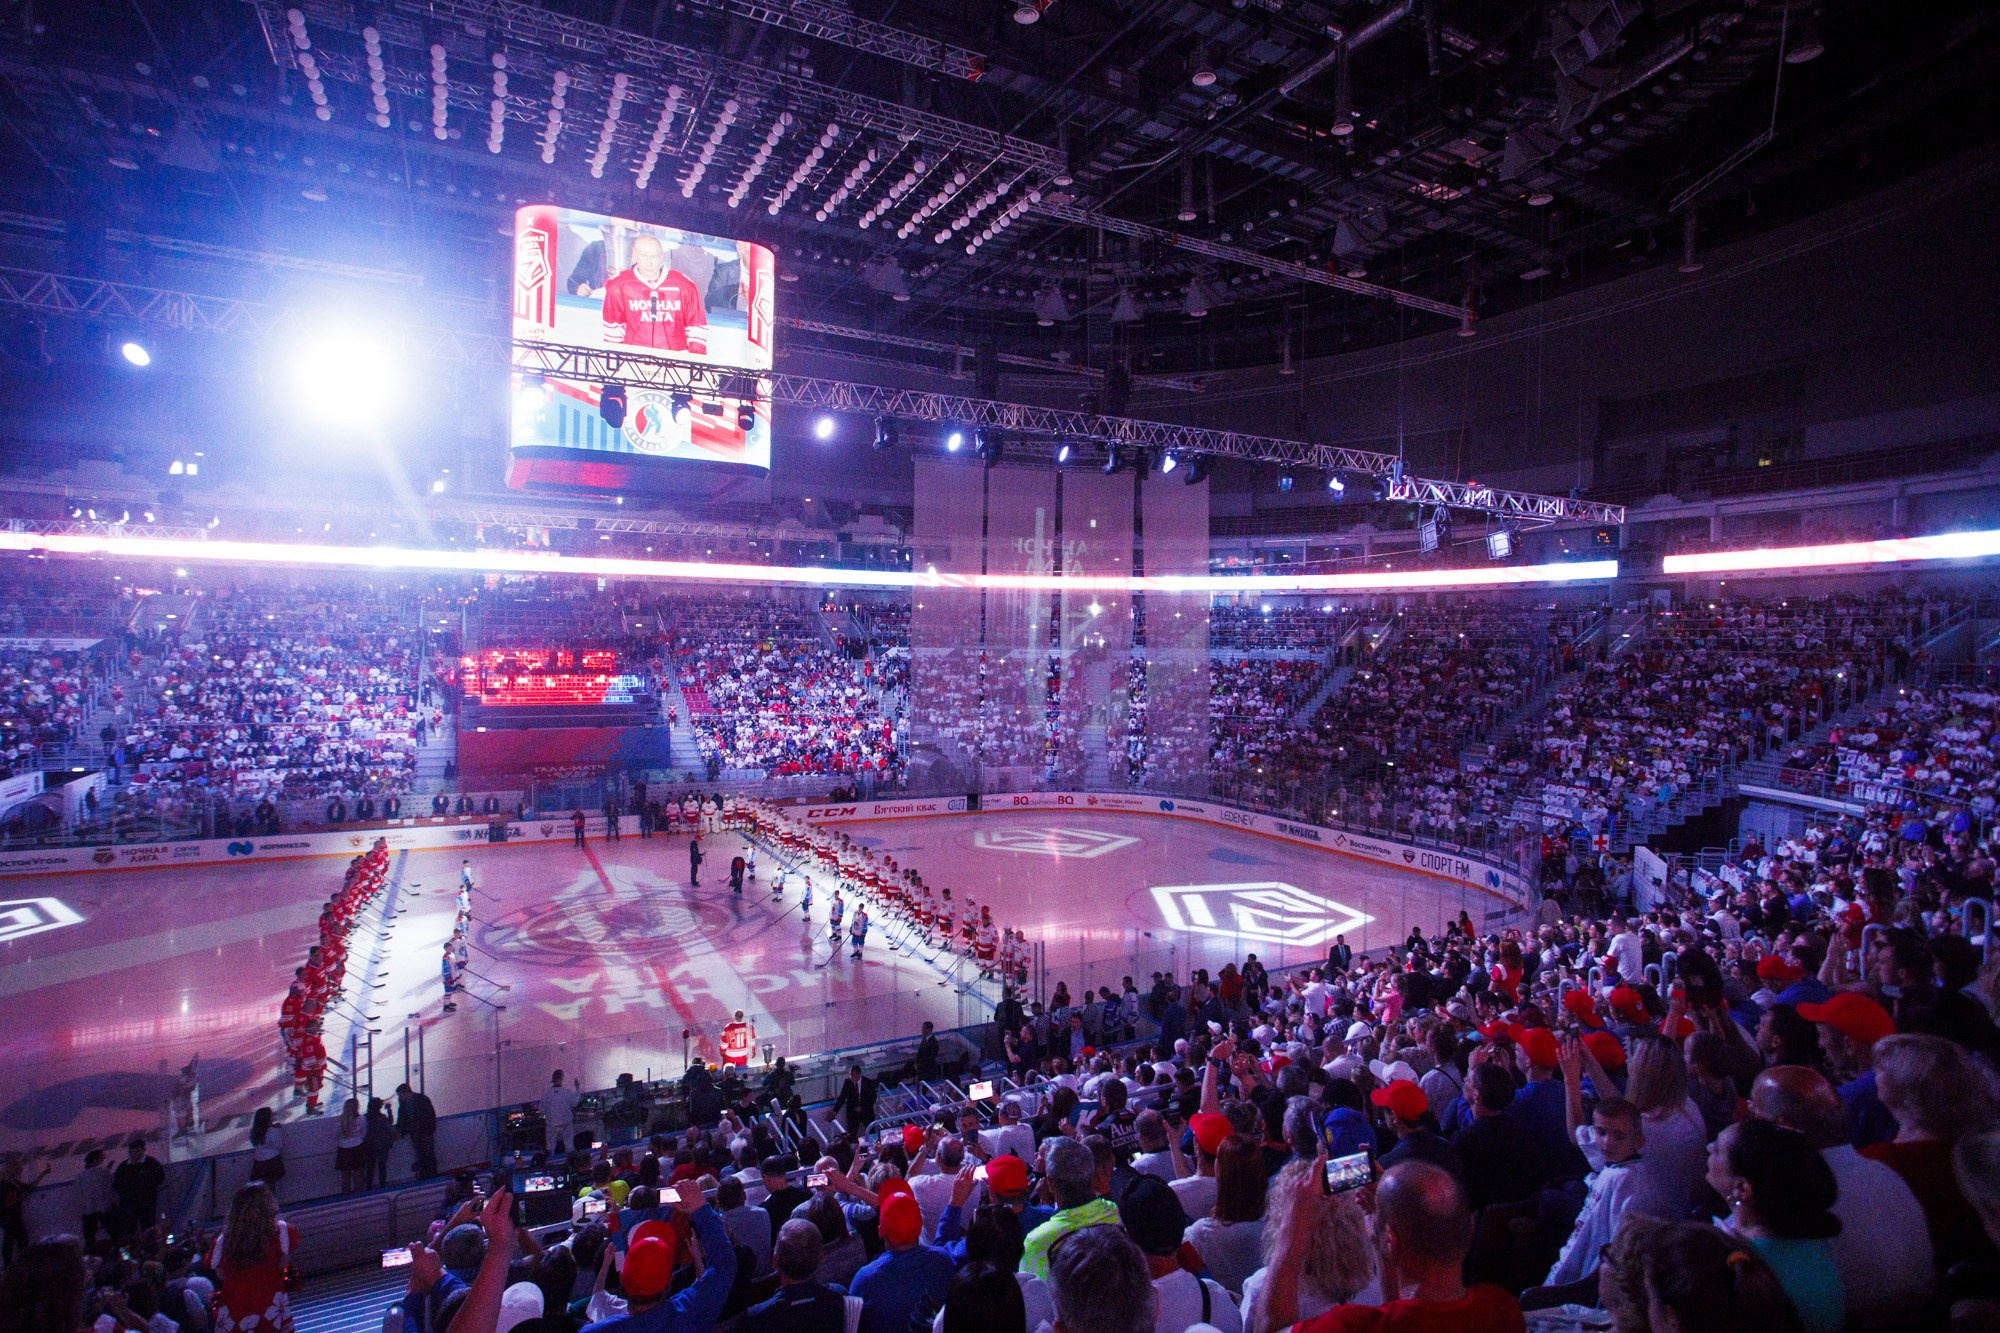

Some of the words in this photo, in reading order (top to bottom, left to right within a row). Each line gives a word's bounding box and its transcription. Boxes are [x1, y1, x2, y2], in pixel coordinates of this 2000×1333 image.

[1013, 796, 1030, 806] BQ
[1057, 795, 1075, 805] BQ
[916, 803, 937, 812] квас
[807, 807, 858, 819] CCM
[1421, 852, 1453, 874] СПОРТ
[1455, 860, 1470, 879] FM
